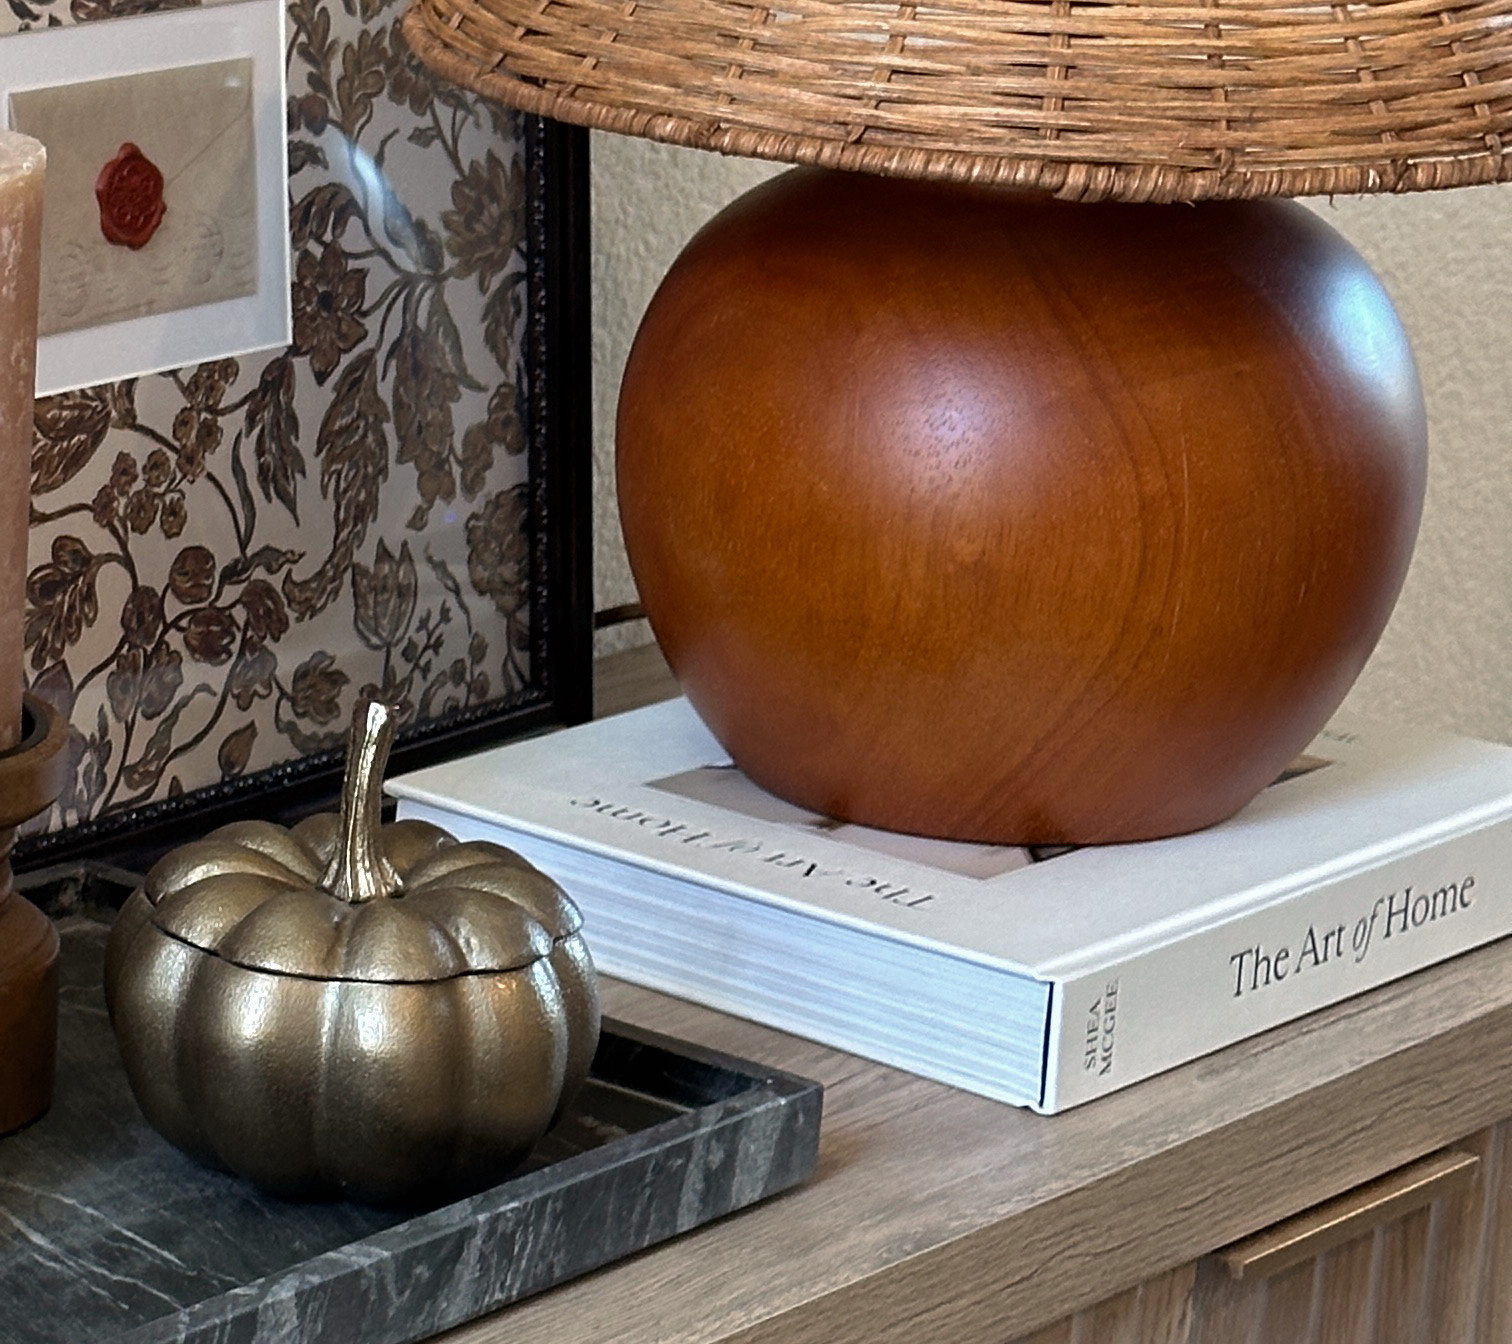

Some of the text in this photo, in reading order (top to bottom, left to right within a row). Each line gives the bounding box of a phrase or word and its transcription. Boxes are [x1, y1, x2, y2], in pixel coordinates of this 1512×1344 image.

[1229, 875, 1475, 997] The Art of Home
[1083, 997, 1101, 1070] SHEA
[1099, 978, 1119, 1076] MCGEE
